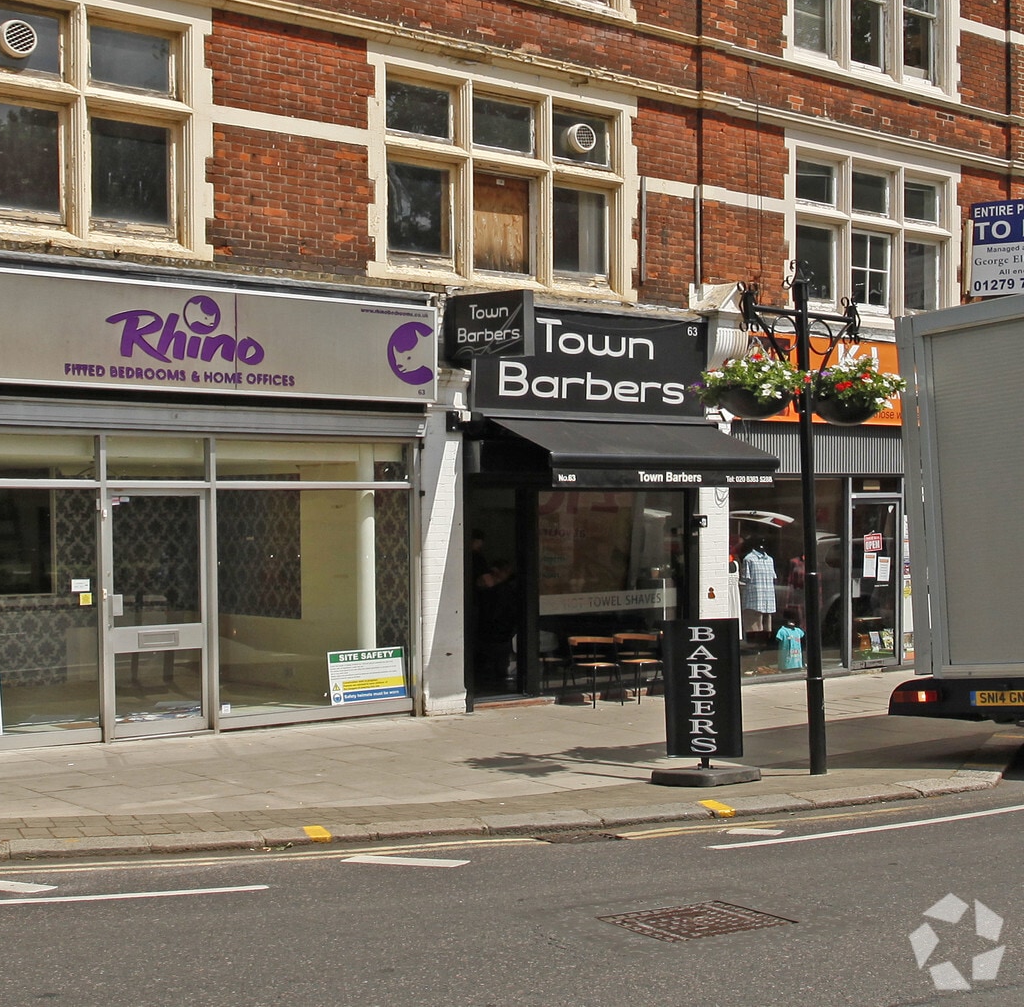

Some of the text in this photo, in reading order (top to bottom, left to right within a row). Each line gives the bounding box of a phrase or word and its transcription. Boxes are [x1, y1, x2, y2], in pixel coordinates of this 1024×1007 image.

[974, 204, 1014, 218] ENTIRE
[974, 220, 1011, 241] TO
[986, 245, 1020, 253] Managed
[974, 257, 1009, 267] George
[974, 278, 1015, 292] 01279
[469, 304, 509, 321] Town
[105, 295, 265, 366] Rhino
[457, 326, 520, 343] Barbers
[686, 325, 698, 337] 63
[536, 317, 655, 360] Town
[64, 363, 295, 387] FITTED BEDROOMS & HOME OFFICES
[498, 360, 685, 405] Barbers
[558, 474, 576, 482] No.63
[638, 472, 702, 483] Town Barbers
[735, 475, 746, 483] 020
[865, 540, 880, 550] OPEN
[588, 595, 622, 608] TOWEL
[625, 593, 661, 605] SHAVES
[338, 650, 394, 662] SITE SAFETY
[686, 626, 718, 753] BARBERS
[979, 692, 1006, 704] SN14
